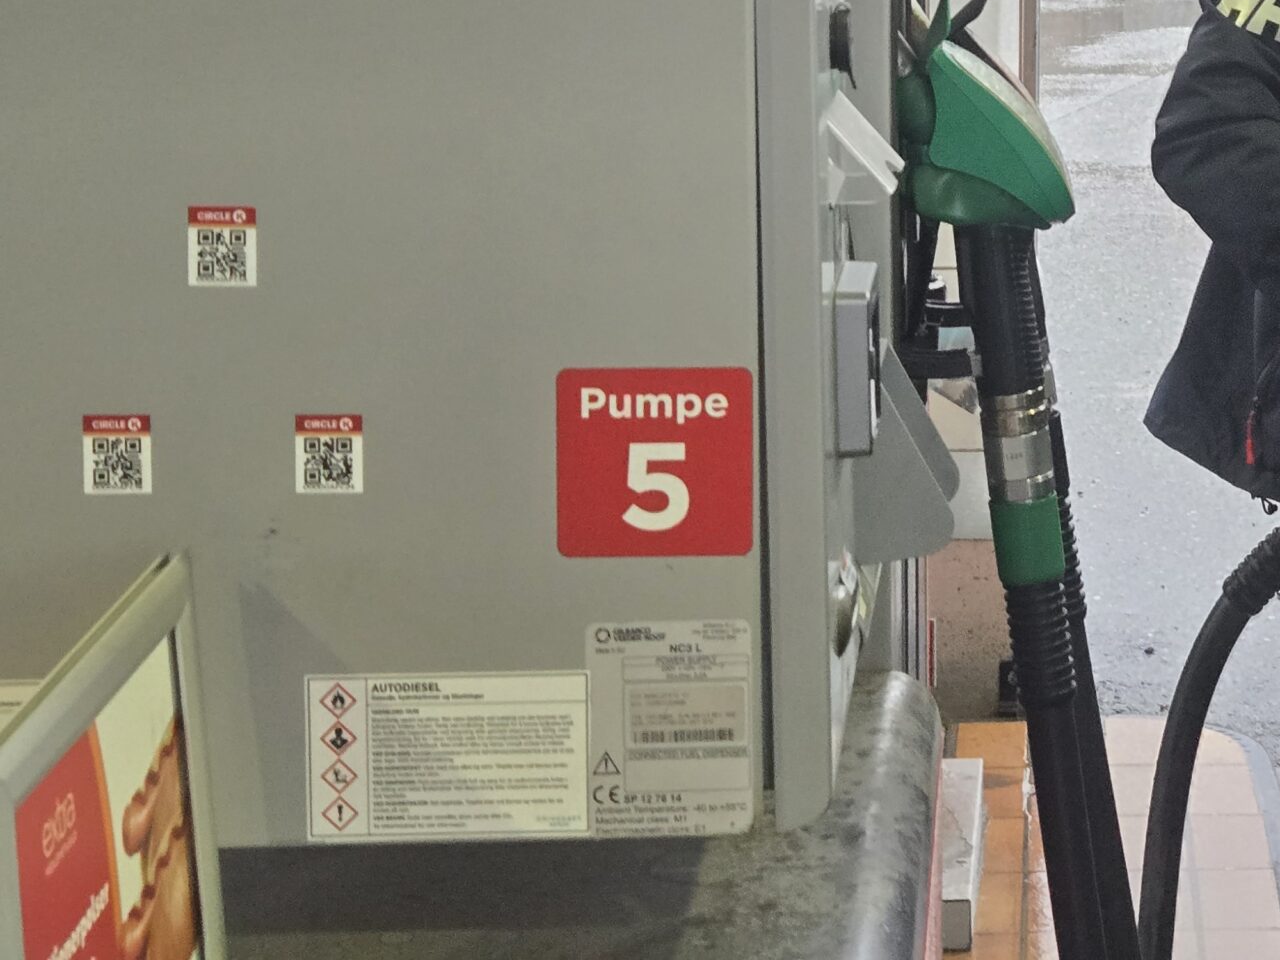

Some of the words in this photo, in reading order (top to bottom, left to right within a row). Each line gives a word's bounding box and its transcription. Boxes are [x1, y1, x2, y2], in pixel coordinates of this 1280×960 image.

[197, 210, 231, 221] CIRCLE
[580, 387, 729, 424] Pumpe
[92, 419, 126, 430] CIRCLE
[304, 419, 338, 429] CIRCLE
[621, 442, 690, 531] 5
[669, 643, 692, 653] NC3
[371, 682, 442, 693] AUTODIESEL
